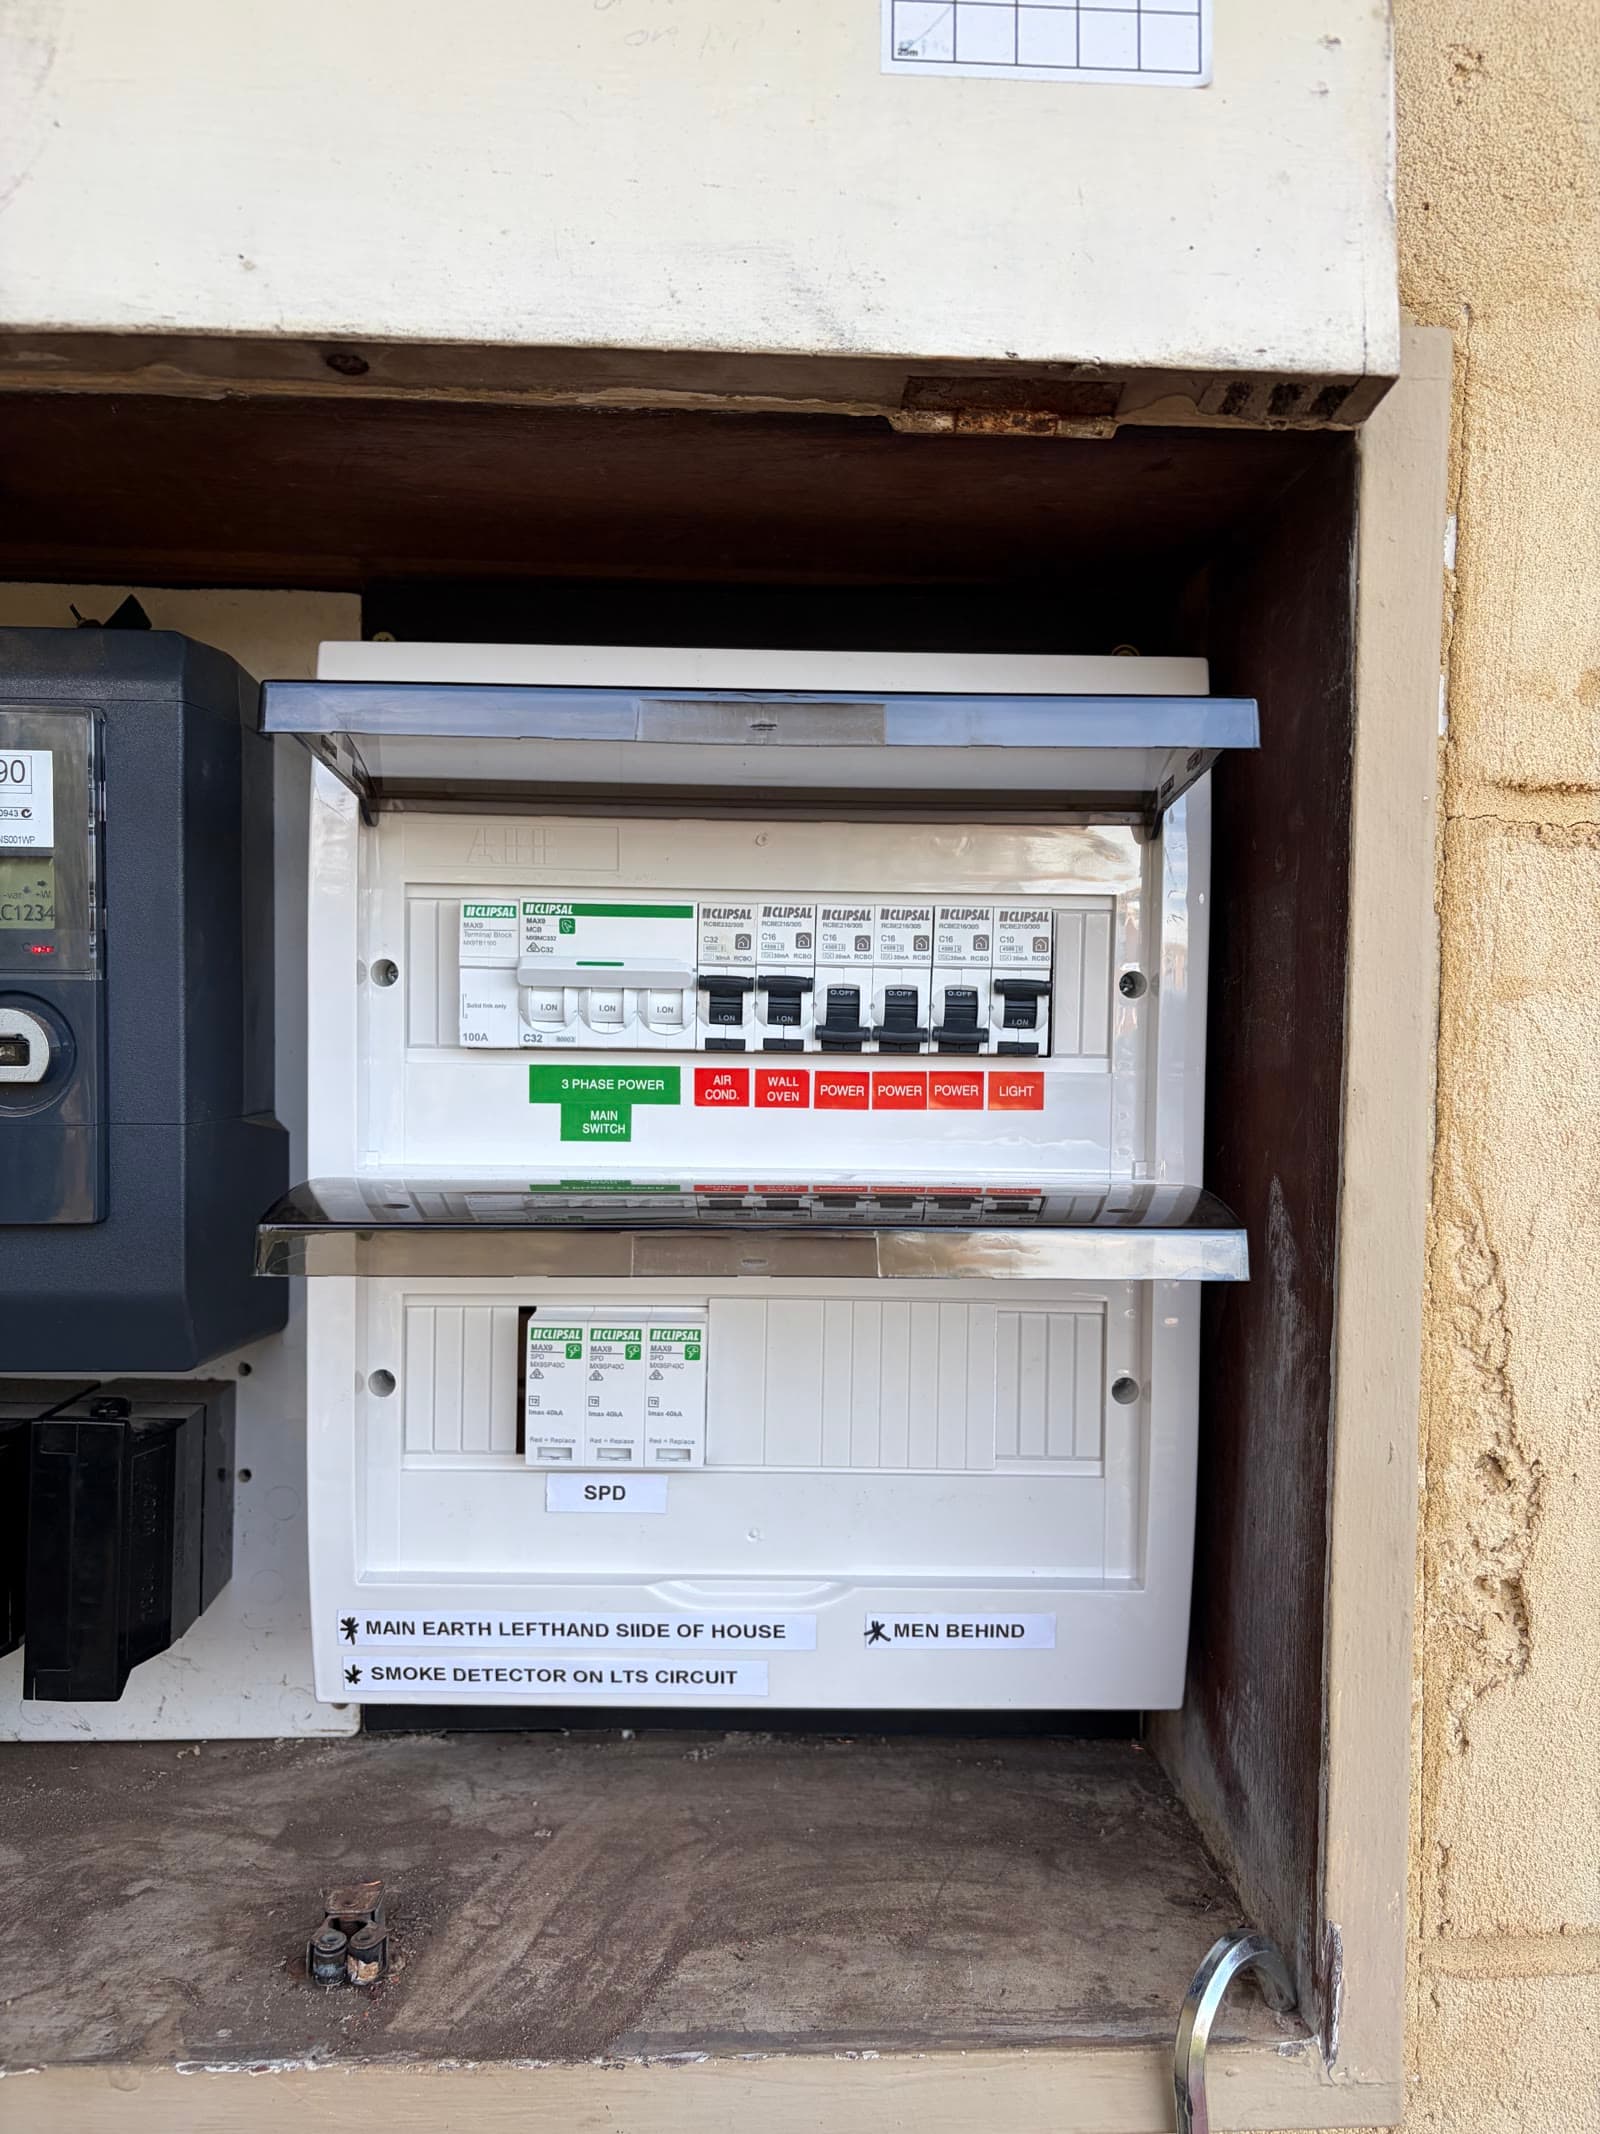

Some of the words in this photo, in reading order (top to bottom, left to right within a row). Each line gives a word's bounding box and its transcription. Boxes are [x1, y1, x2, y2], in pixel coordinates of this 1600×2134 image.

[0, 904, 55, 921] C1234
[475, 906, 515, 917] CLIPSAL
[534, 903, 574, 914] CLIPSAL
[712, 908, 752, 920] CLIPSAL
[772, 907, 812, 919] CLIPSAL
[831, 909, 871, 921] CLIPSAL
[890, 910, 930, 921] CLIPSAL
[950, 909, 990, 921] CLIPSAL
[1009, 911, 1049, 923] CLIPSAL
[761, 933, 776, 941] C16
[822, 934, 837, 942] C16
[938, 935, 954, 943] C16
[463, 1033, 489, 1042] 100A
[523, 1034, 543, 1043] C32
[561, 1079, 569, 1090] 3
[572, 1079, 615, 1090] PHASE
[617, 1080, 665, 1091] POWER
[713, 1075, 732, 1086] AIR
[767, 1076, 799, 1087] WALL
[705, 1089, 740, 1100] COND.
[820, 1085, 865, 1096] POWER
[878, 1085, 922, 1096] POWER
[934, 1085, 979, 1096] POWER
[999, 1086, 1034, 1097] LIGHT
[766, 1091, 799, 1102] OVEN
[590, 1110, 618, 1121] MAIN
[582, 1123, 626, 1134] SWITCH
[542, 1329, 581, 1340] CLIPSAL
[602, 1330, 640, 1341] CLIPSAL
[661, 1330, 699, 1342] CLIPSAL
[584, 1485, 626, 1501] SPD
[366, 1620, 416, 1636] MAIN
[423, 1620, 492, 1637] EARTH
[499, 1621, 609, 1638] LEFTHAND
[616, 1623, 670, 1639] SIIDE
[676, 1623, 705, 1638] OF
[712, 1624, 786, 1639] HOUSE
[894, 1624, 939, 1638] MEN
[946, 1624, 1025, 1638] BEHIND
[371, 1666, 446, 1681] SMOKE
[453, 1667, 566, 1683] DETECTOR
[573, 1668, 604, 1683] ON
[610, 1669, 649, 1684] LTS
[654, 1669, 738, 1685] CIRCUIT
